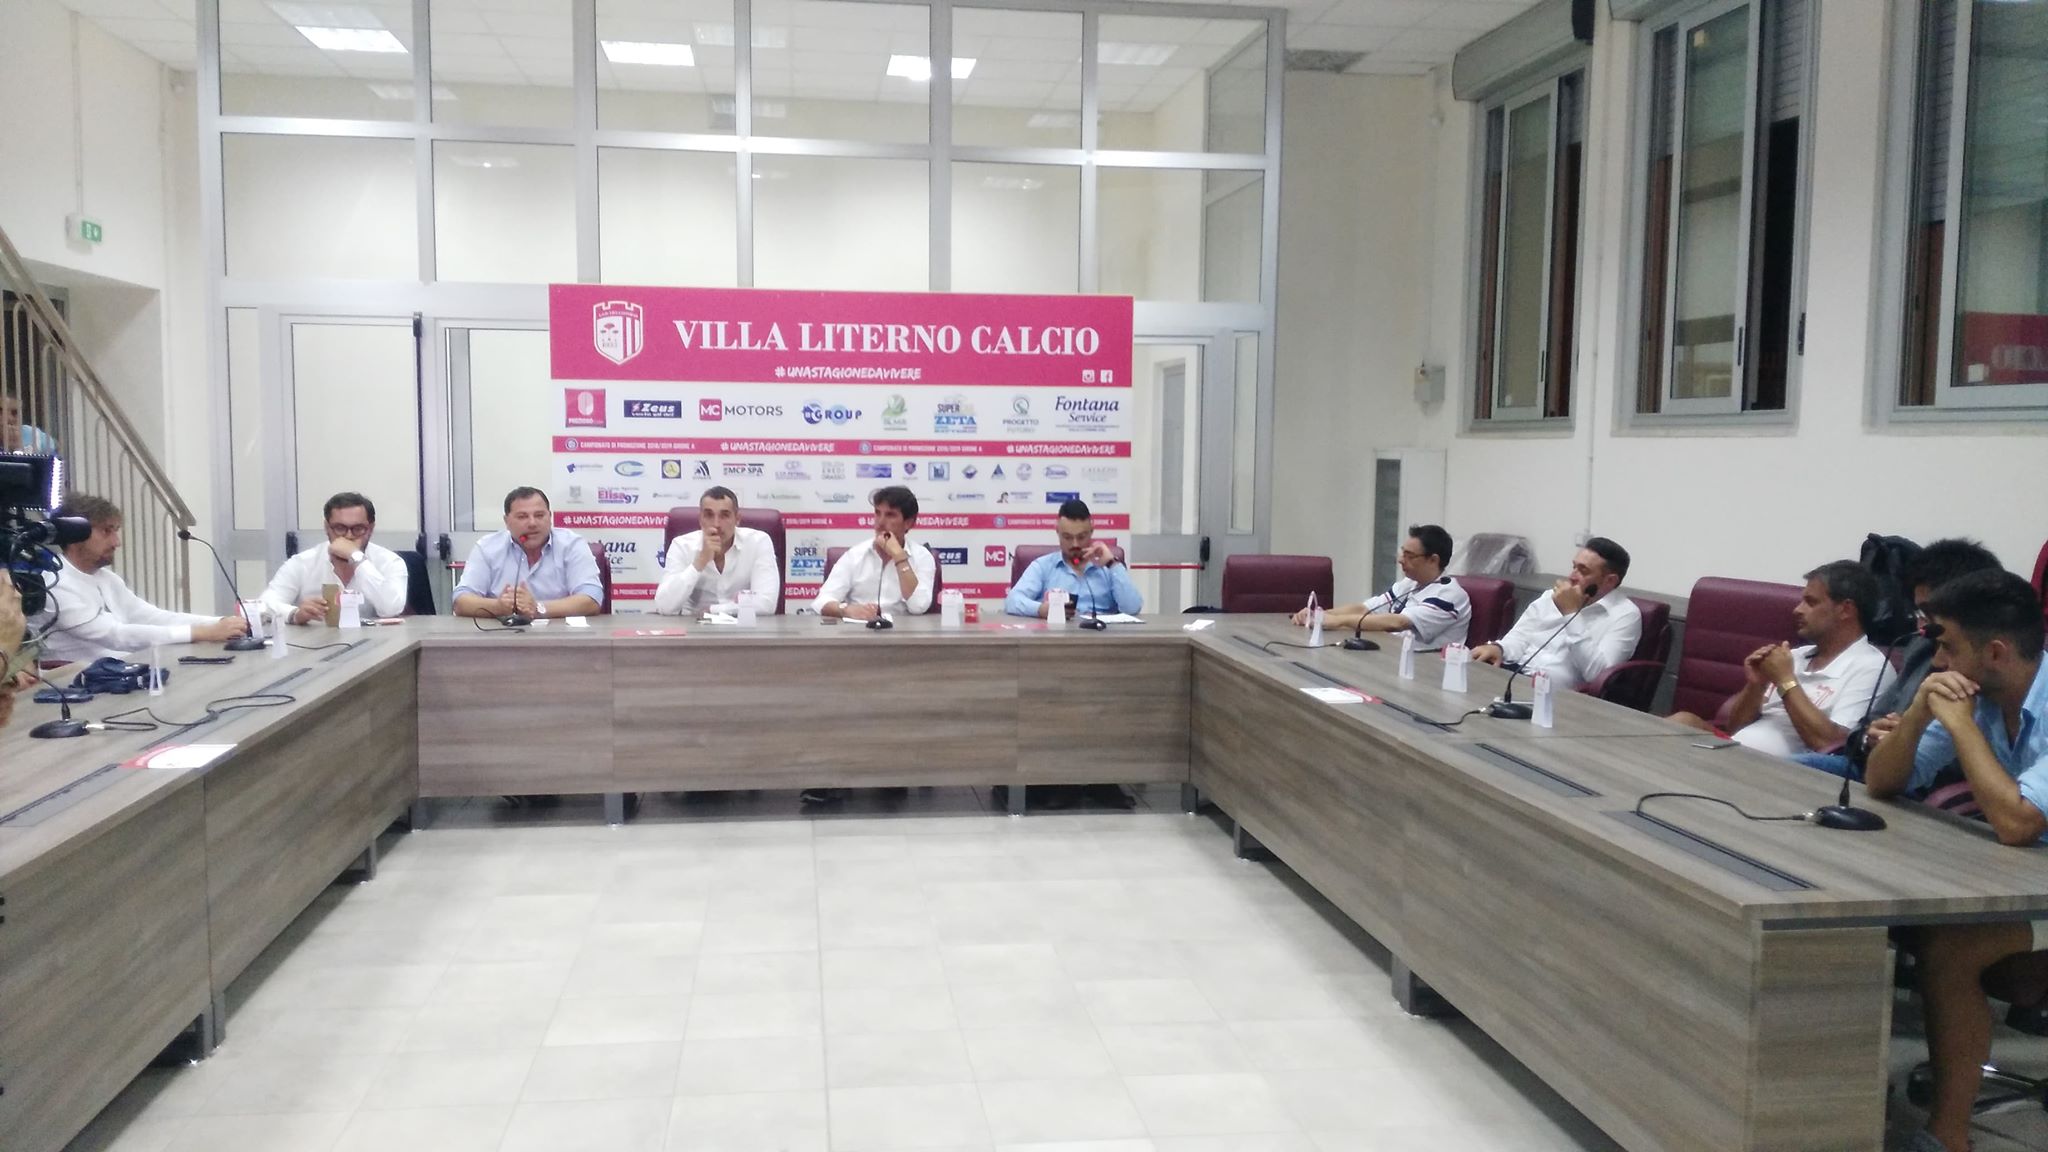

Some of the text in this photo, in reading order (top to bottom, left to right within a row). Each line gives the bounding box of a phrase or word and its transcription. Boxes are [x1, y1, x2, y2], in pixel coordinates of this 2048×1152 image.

[673, 320, 1099, 356] VILLA LITERNO CALCIO
[774, 366, 922, 380] #UNASTAGIONEDAVIVERE
[640, 403, 675, 412] Zeus
[937, 403, 960, 413] SUPER
[1055, 395, 1119, 412] Fontana
[700, 404, 783, 416] MC MOTORS
[934, 415, 977, 425] ZETA
[1068, 412, 1107, 423] Service
[720, 441, 835, 453] #UNASTAGIONEDAVIVERE
[1006, 444, 1116, 456] #UNASTAGIONEDAVIVERE
[728, 466, 746, 474] MCP
[597, 490, 639, 504] Elisa 97
[563, 515, 669, 526] #UNASTAGIONEDAVIVE
[794, 547, 817, 557] SUPER
[938, 551, 962, 560] eus
[985, 551, 1005, 562] MC
